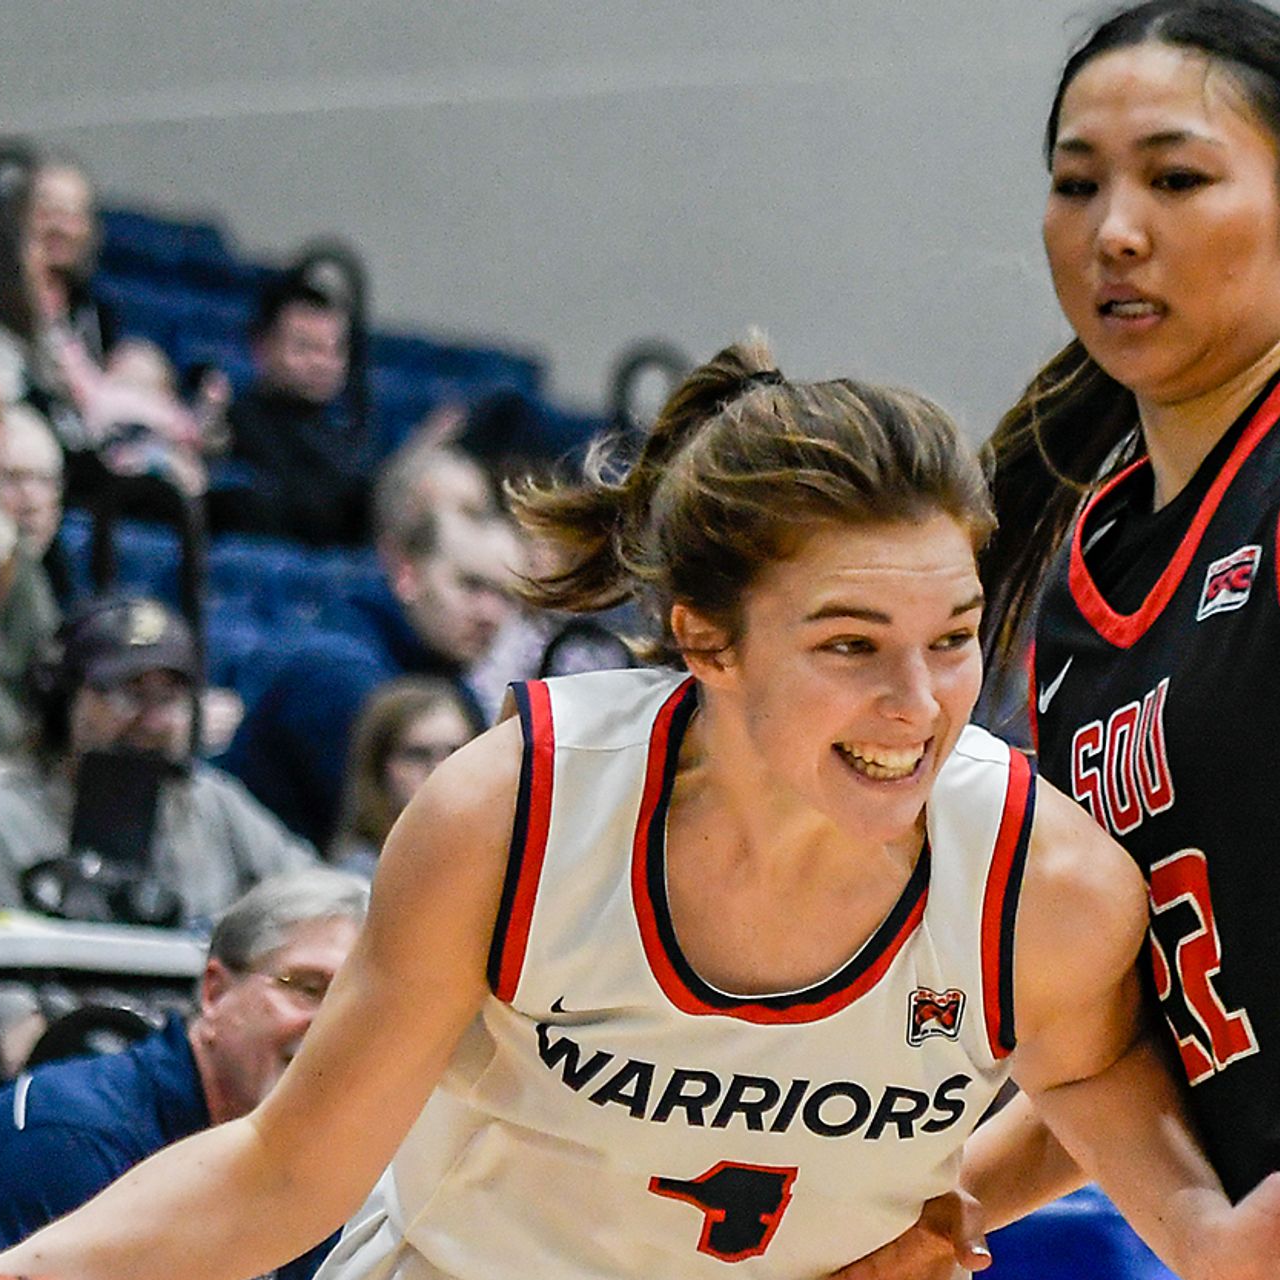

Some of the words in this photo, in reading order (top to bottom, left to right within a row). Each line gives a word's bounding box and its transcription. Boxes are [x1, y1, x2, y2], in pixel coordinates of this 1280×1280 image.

[1072, 677, 1176, 836] SOU
[535, 1022, 974, 1141] WARRIORS
[647, 1159, 800, 1264] 1
